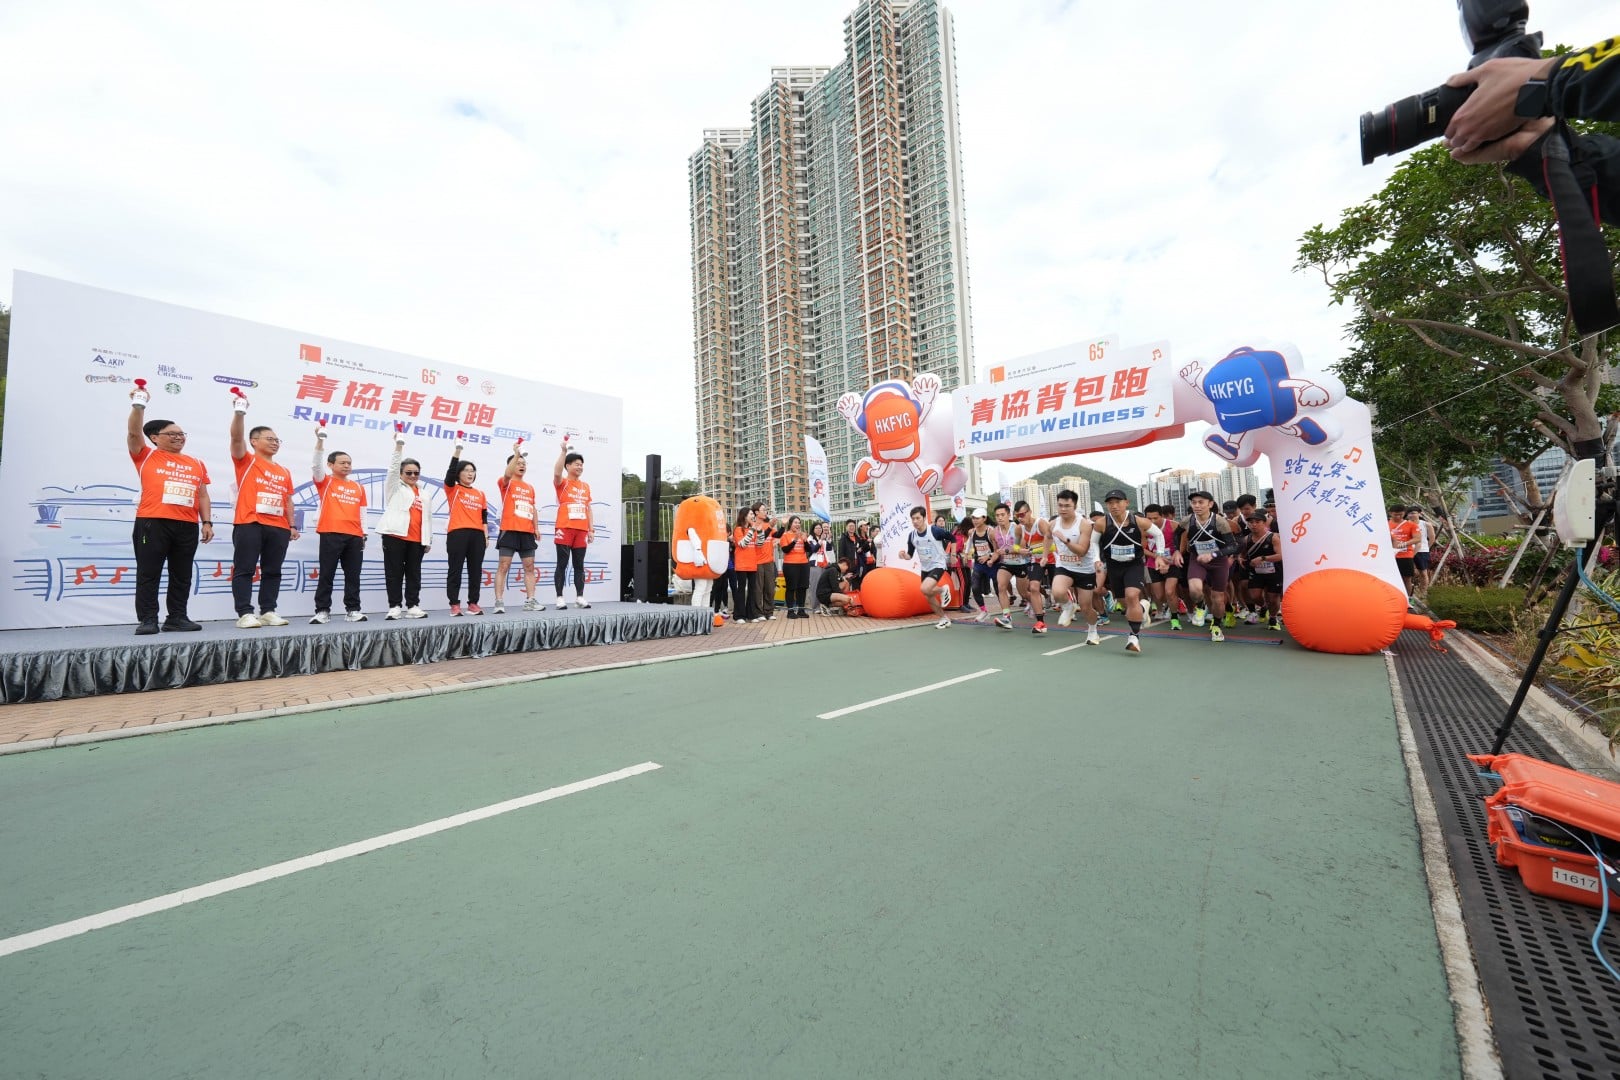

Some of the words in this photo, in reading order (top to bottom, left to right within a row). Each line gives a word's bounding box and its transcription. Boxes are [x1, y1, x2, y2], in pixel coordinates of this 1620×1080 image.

[296, 374, 498, 428] 青協背包跑
[971, 367, 1151, 426] 青協背包跑
[1209, 377, 1255, 400] HKFYG
[875, 412, 912, 435] HKFYG
[970, 406, 1146, 444] RunForWellness
[166, 461, 192, 471] Run
[1284, 453, 1366, 490] 踏出第一步
[1554, 871, 1597, 888] 11617
